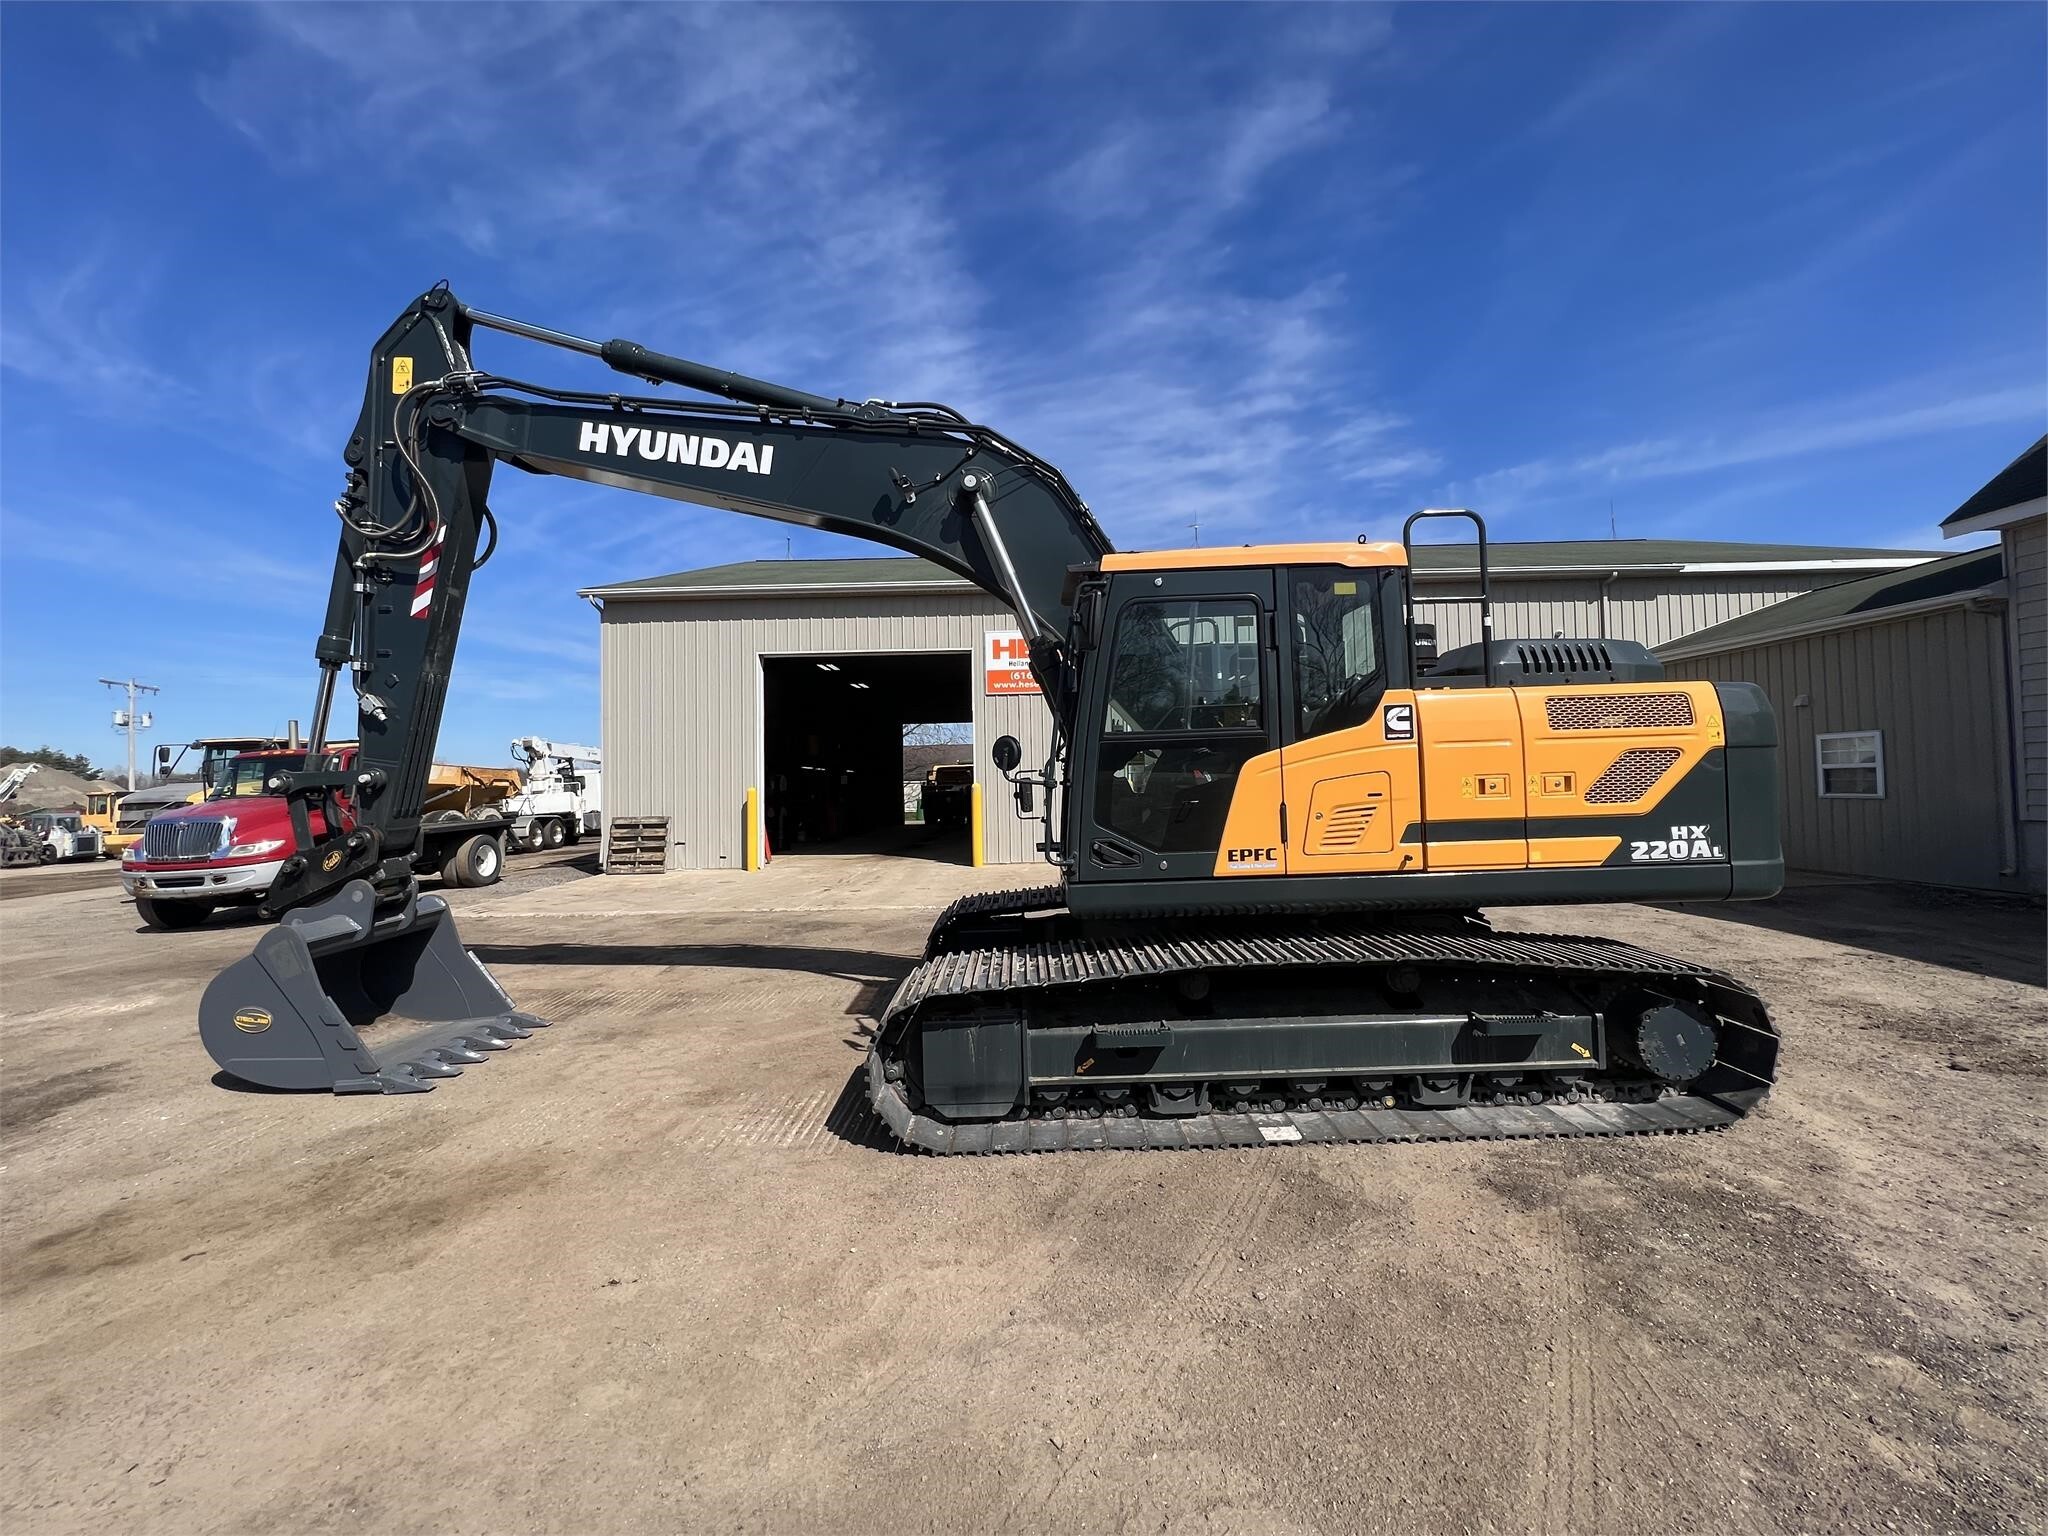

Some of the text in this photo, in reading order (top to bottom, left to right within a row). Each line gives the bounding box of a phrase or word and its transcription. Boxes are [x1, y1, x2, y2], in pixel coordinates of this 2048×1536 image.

[579, 421, 774, 475] HYUNDAI
[1671, 825, 1707, 839] HX
[1227, 848, 1278, 862] EPFC
